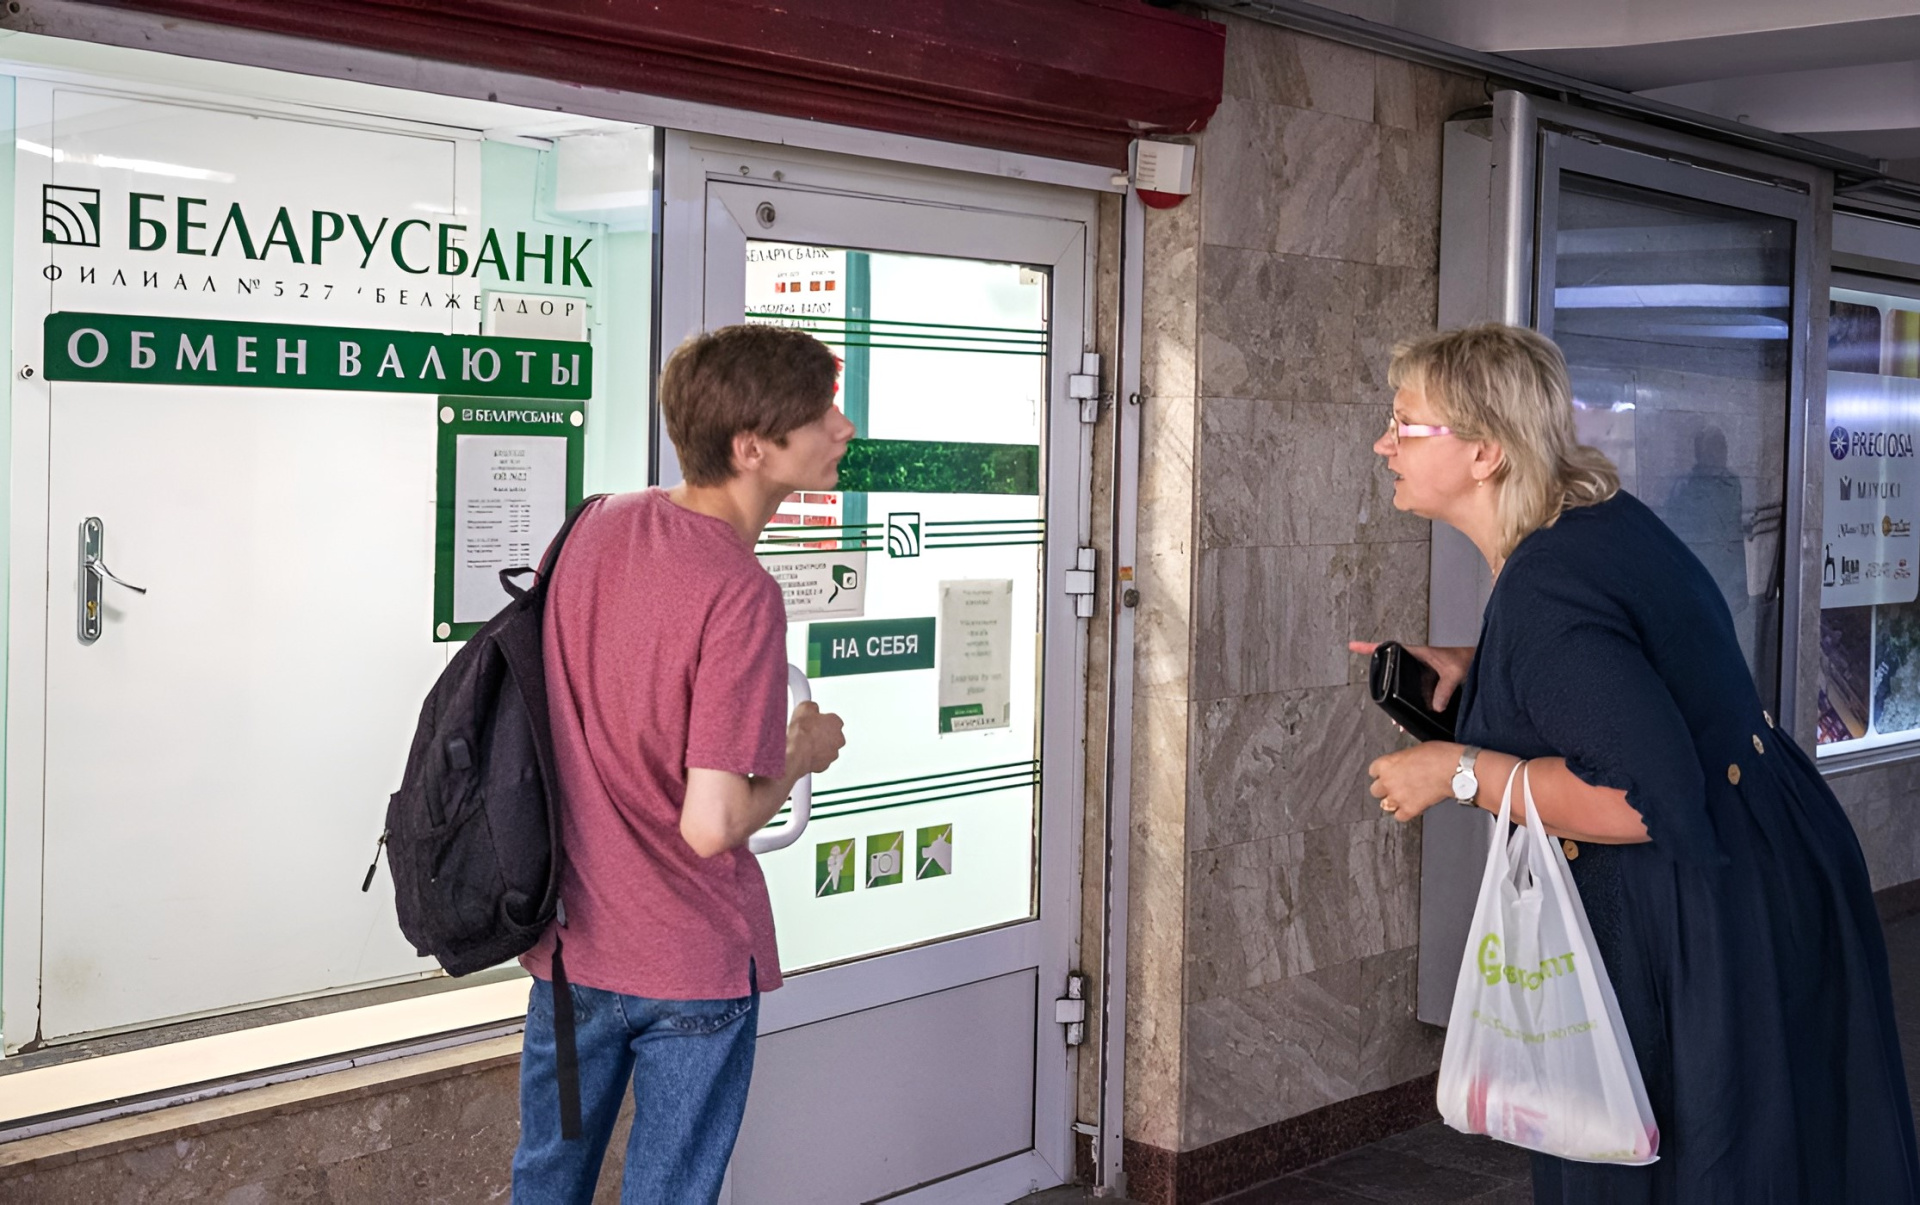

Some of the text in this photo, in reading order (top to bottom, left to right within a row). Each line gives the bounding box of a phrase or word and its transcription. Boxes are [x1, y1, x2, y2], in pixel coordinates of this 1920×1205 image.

[129, 192, 593, 287] БЕЛАРУСБАНК
[43, 264, 216, 292] ФИЛИАЛ
[67, 327, 580, 386] ОБМЕН ВАЛЮТЫ
[475, 408, 564, 423] БЕЛАРУСБАНК
[1851, 431, 1914, 457] PRECIOSA
[832, 634, 919, 659] НА СЕБЯ
